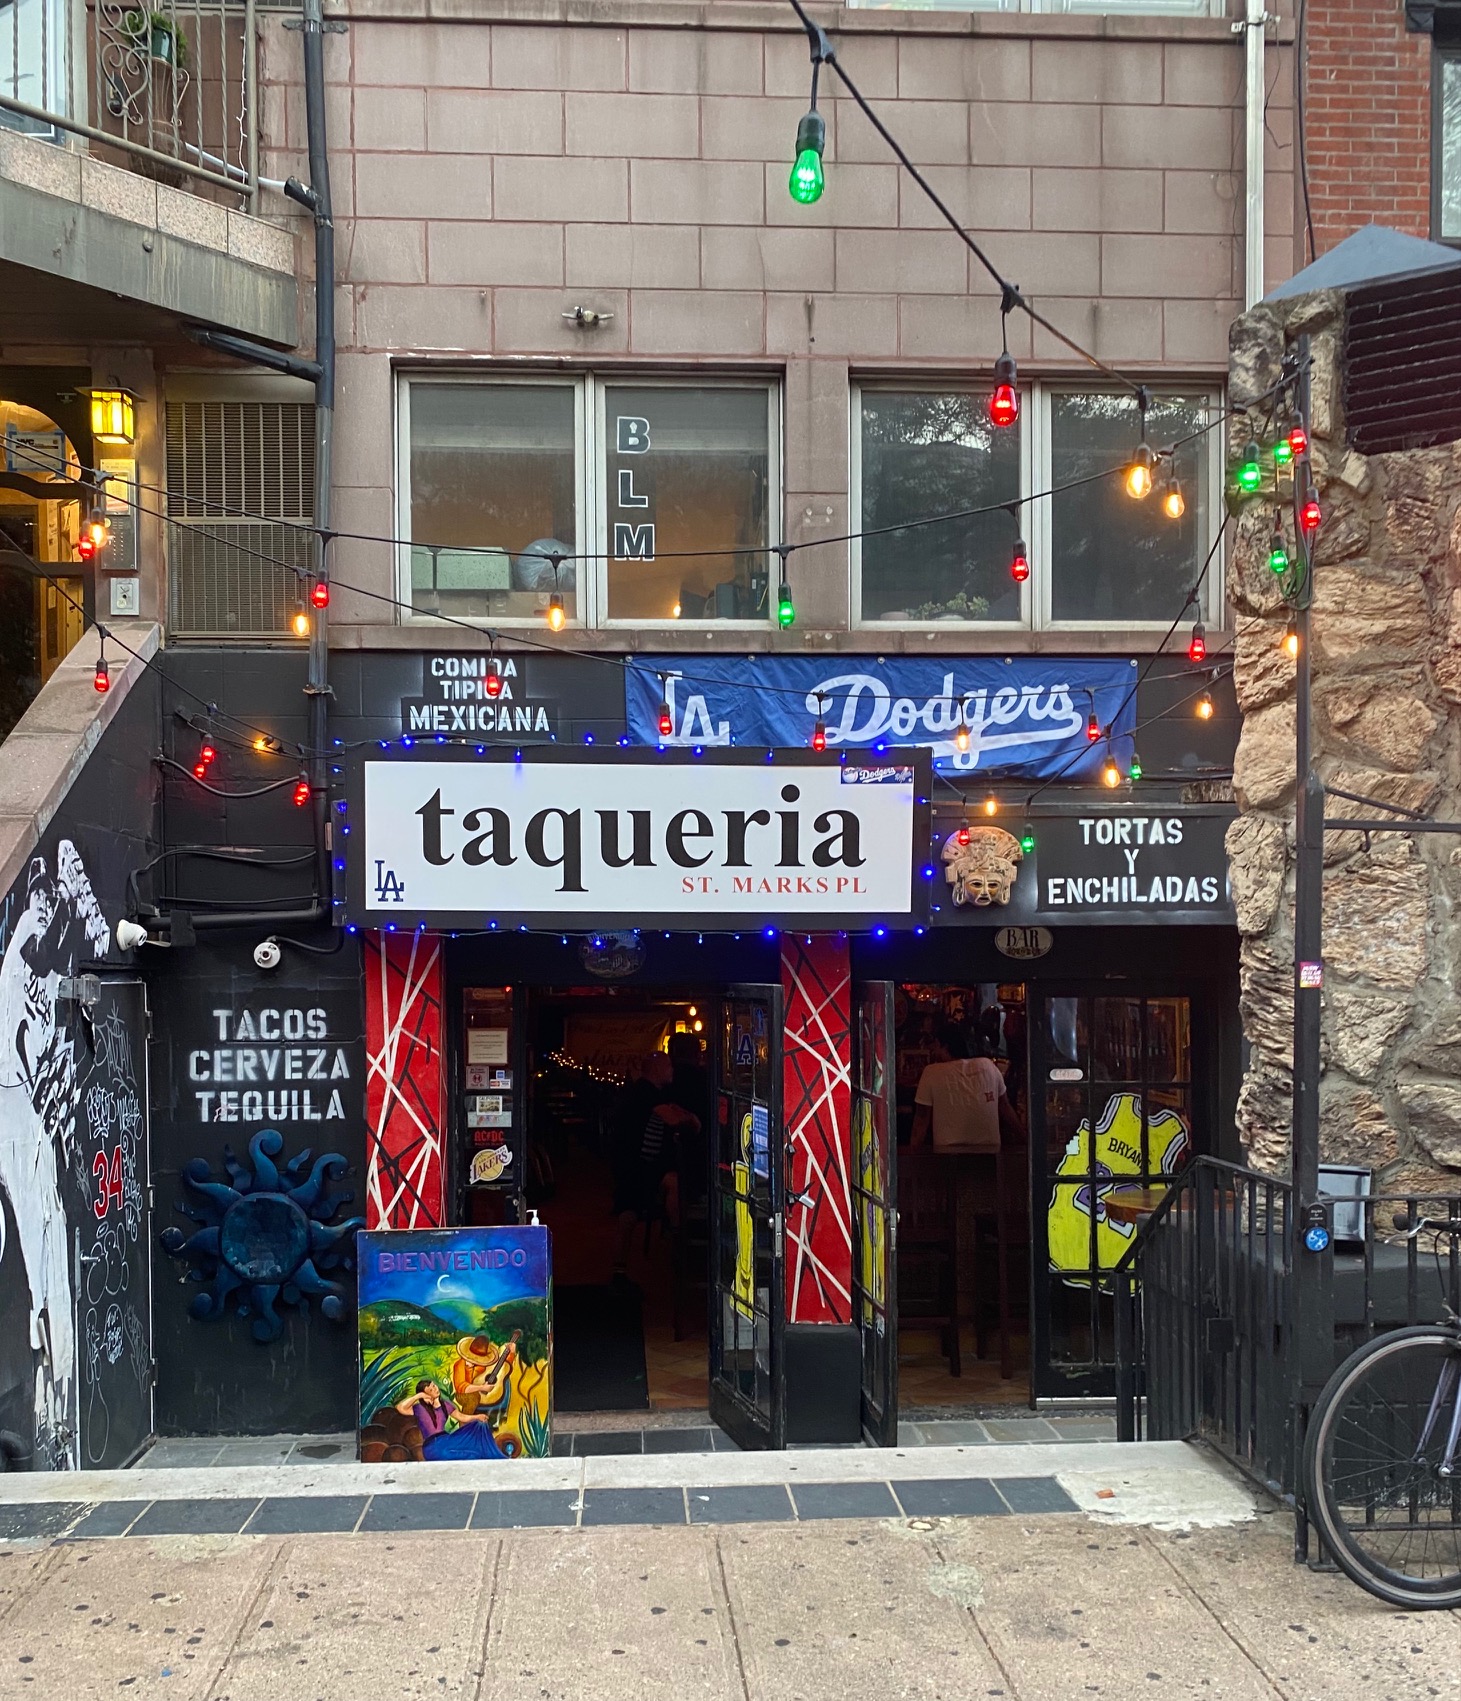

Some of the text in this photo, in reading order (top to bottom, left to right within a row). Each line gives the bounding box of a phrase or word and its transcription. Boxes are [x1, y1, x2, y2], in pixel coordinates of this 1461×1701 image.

[410, 704, 550, 732] MEXICANA
[657, 670, 1083, 770] LA Dodgers
[859, 766, 897, 784] Dodgers
[415, 783, 868, 892] taqueria
[1078, 818, 1184, 845] TORTAS
[1123, 848, 1140, 875] Y
[374, 860, 405, 902] LA
[682, 876, 868, 895] ST. MARKS PL
[1048, 876, 1219, 904] ENCHILADAS
[1006, 928, 1039, 948] BAR
[212, 1008, 328, 1041] TACOS
[189, 1048, 350, 1081] CERVEZA
[195, 1088, 346, 1123] TEQUILA
[473, 1151, 508, 1180] LAKERS
[1107, 1137, 1152, 1170] BRYAN
[93, 1144, 123, 1219] 34
[378, 1248, 527, 1273] BIENVENIDO
